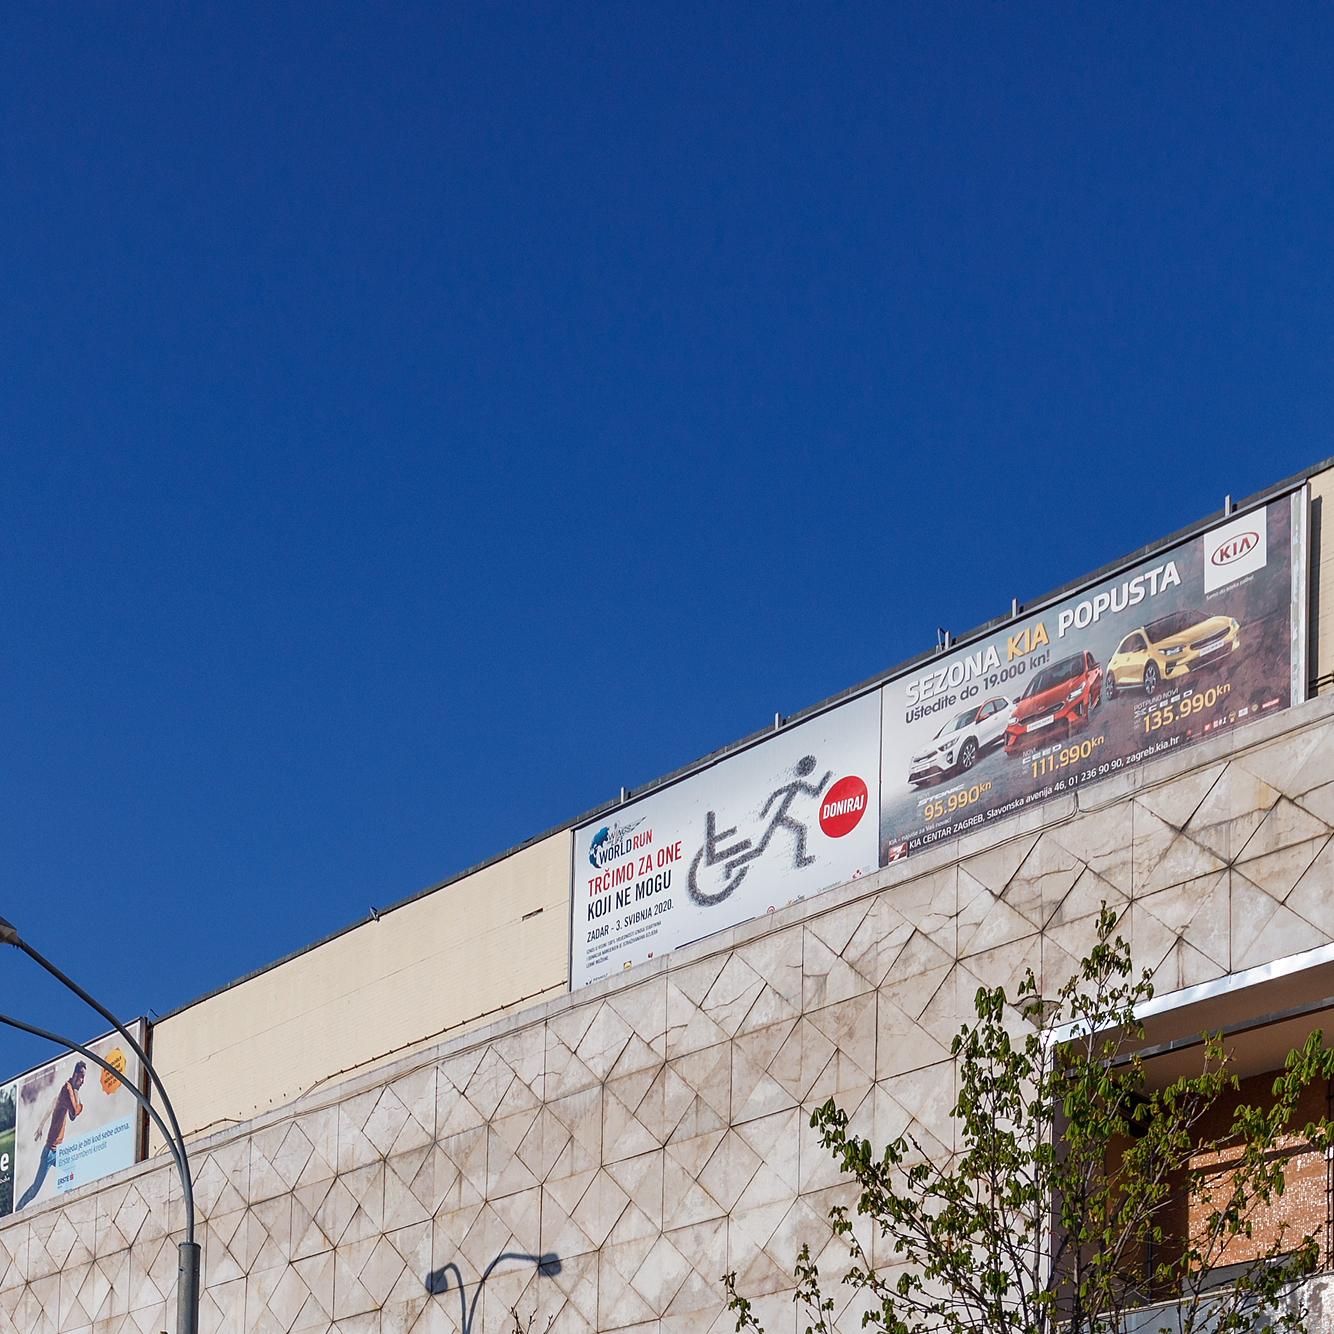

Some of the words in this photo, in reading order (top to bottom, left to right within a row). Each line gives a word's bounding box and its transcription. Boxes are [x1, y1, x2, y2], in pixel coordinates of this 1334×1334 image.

[1219, 536, 1252, 562] KIA
[905, 645, 1001, 708] SEZONA
[1007, 622, 1050, 662] KIA
[1058, 560, 1182, 638] POPUSTA
[905, 694, 957, 724] Uštedite
[960, 684, 979, 701] do
[983, 661, 1026, 691] 19.000
[1030, 649, 1051, 671] kn!
[822, 795, 865, 820] DONIRAJ
[909, 839, 921, 850] KIA
[922, 826, 952, 845] CENTAR
[953, 813, 985, 834] ZAGREB,
[986, 798, 1025, 820] Slavonska
[1025, 786, 1053, 803] avenija
[1054, 781, 1067, 791] 46,
[1068, 777, 1078, 787] 01
[1081, 768, 1097, 782] 236
[1098, 763, 1109, 774] 90
[1111, 757, 1124, 768] 90,
[1126, 735, 1180, 764] zagreb.kia.hr
[587, 895, 611, 922] KOJI
[615, 886, 632, 910] NE
[635, 869, 672, 902] MOGU
[588, 862, 634, 897] TRČIMO
[638, 854, 653, 876] ZA
[657, 840, 682, 868] ONE
[587, 924, 609, 943] ZADAR
[616, 919, 623, 931] 3.
[624, 907, 653, 928] SVIBNJA
[654, 898, 674, 916] 2020.
